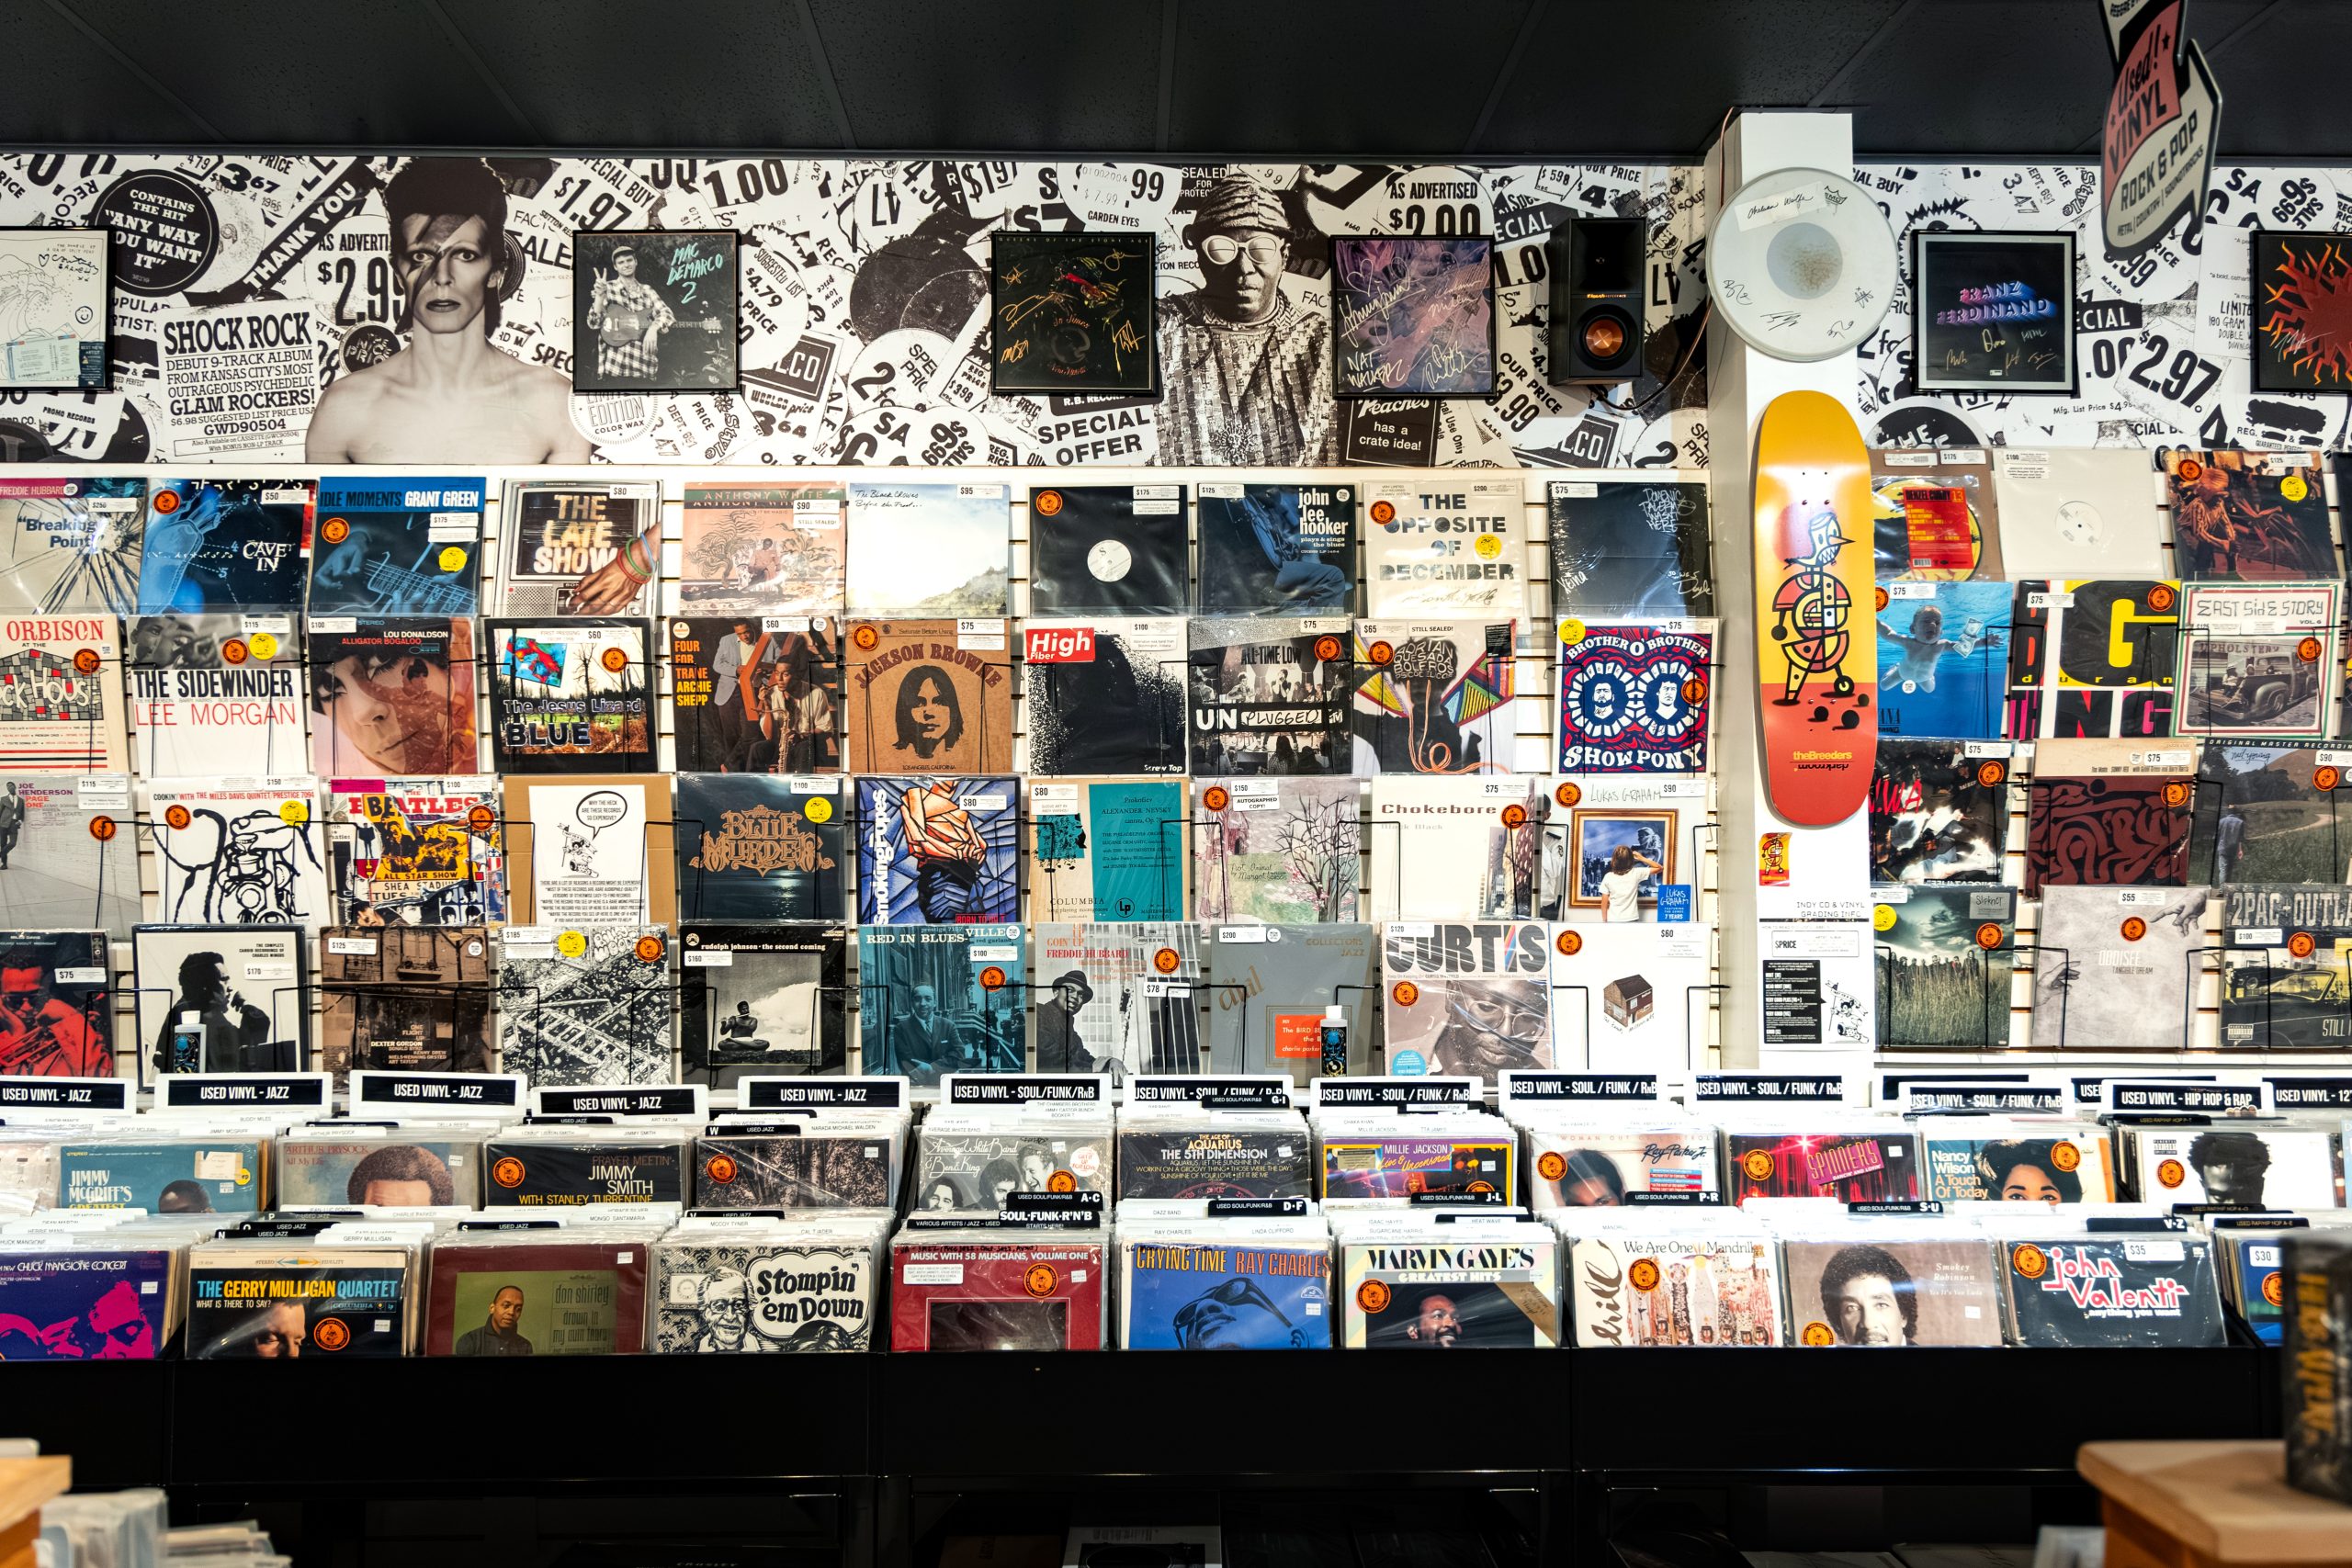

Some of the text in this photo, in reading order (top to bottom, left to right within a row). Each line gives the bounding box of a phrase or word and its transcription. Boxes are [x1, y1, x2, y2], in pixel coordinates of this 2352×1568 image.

[2109, 79, 2167, 174] VINYL
[2120, 161, 2155, 211] ROCK
[2169, 110, 2198, 167] POP
[704, 160, 788, 207] 1.00
[1390, 181, 1478, 200] AS ADVERTISED
[130, 189, 194, 213] CONTAINS
[132, 201, 187, 220] THE HIT
[1088, 211, 1139, 227] GARDEN EYES
[158, 223, 200, 244] WAY
[243, 184, 356, 290] THANK YOU
[148, 240, 202, 264] WANT
[681, 281, 696, 304] 2
[1959, 281, 2023, 303] FRANZ
[1936, 299, 2051, 325] FERDINAND
[164, 311, 312, 355] SHOCK ROCK
[166, 349, 312, 371] DEBUT 9-TRACK ALBUM
[167, 372, 198, 384] FROM
[203, 367, 246, 381] KANSAS
[285, 363, 313, 375] MOST
[168, 376, 314, 398] OUTRAGEOUS PSYCHEDELIC
[170, 389, 315, 415] GLAM ROCKERS!
[204, 419, 286, 435] GWD90504
[1039, 410, 1150, 445] SPECIAL
[1374, 422, 1408, 435] has a
[1057, 434, 1142, 465] OFFER
[1359, 436, 1421, 450] crate idea!
[265, 492, 278, 501] $50
[404, 491, 480, 508] GRANT GREEN
[797, 501, 810, 510] $90
[1297, 488, 1329, 508] john
[1419, 494, 1466, 511] THE
[553, 494, 605, 521] THE
[1303, 505, 1324, 523] lee
[542, 521, 612, 547] LATE
[1299, 518, 1349, 536] hooker
[1384, 516, 1507, 534] OPPOSITE
[1431, 540, 1461, 557] OF
[256, 557, 278, 572] IN
[534, 547, 620, 574] SHOW
[1379, 564, 1514, 581] DECEMBER
[6, 620, 104, 641] ORBISON
[766, 620, 779, 628] $60
[961, 621, 974, 630] $75
[674, 641, 699, 652] FOUR
[1031, 631, 1091, 657] High
[1566, 637, 1629, 660] BROTHER
[1650, 636, 1708, 659] BROTHER
[1030, 651, 1055, 660] Fiber
[855, 645, 1001, 688] JACKSON BROWNE
[134, 671, 293, 698] THE SIDEWINDER
[676, 681, 712, 693] ARCHIE
[504, 699, 640, 714] The Jesus Lizard
[677, 694, 707, 706] SHEPP
[136, 704, 296, 726] LEE MORGAN
[1196, 708, 1237, 730] UN
[505, 723, 592, 747] BLUE
[1564, 743, 1702, 770] SHOW PONY
[1792, 750, 1853, 761] theBreeders
[1391, 805, 1506, 815] Chokebore
[2121, 893, 2136, 903] $55
[1385, 925, 1545, 972] CURTIS
[200, 1086, 288, 1099] USED VINYL JAZZ
[2122, 1091, 2252, 1106] USED VINYL HIP HOP & RAP
[1807, 1139, 1879, 1179] SPINNERS
[1931, 1151, 1970, 1165] Nancy
[1932, 1163, 1975, 1175] Wilson
[1945, 1176, 1981, 1187] Touch
[1955, 1187, 1988, 1201] Today
[1624, 1241, 1643, 1253] We
[1645, 1241, 1667, 1253] Are
[1668, 1241, 1692, 1253] One
[2130, 1245, 2146, 1256] $35
[1136, 1251, 1329, 1278] CRYING TIME RAY CHARLES
[1367, 1250, 1451, 1269] MARVIN
[1935, 1263, 1970, 1272] Smokey
[2042, 1247, 2124, 1291] john
[1398, 1272, 1501, 1282] GREATEST HITS
[1934, 1273, 1974, 1282] Robinson
[198, 1281, 397, 1299] THE GERRY MULLIGAN QUARTET
[2064, 1278, 2190, 1309] Valenti
[197, 1300, 215, 1308] WHAT
[217, 1300, 224, 1308] IS
[226, 1300, 244, 1308] THERE
[246, 1300, 255, 1308] TO
[800, 1297, 864, 1321] Down
